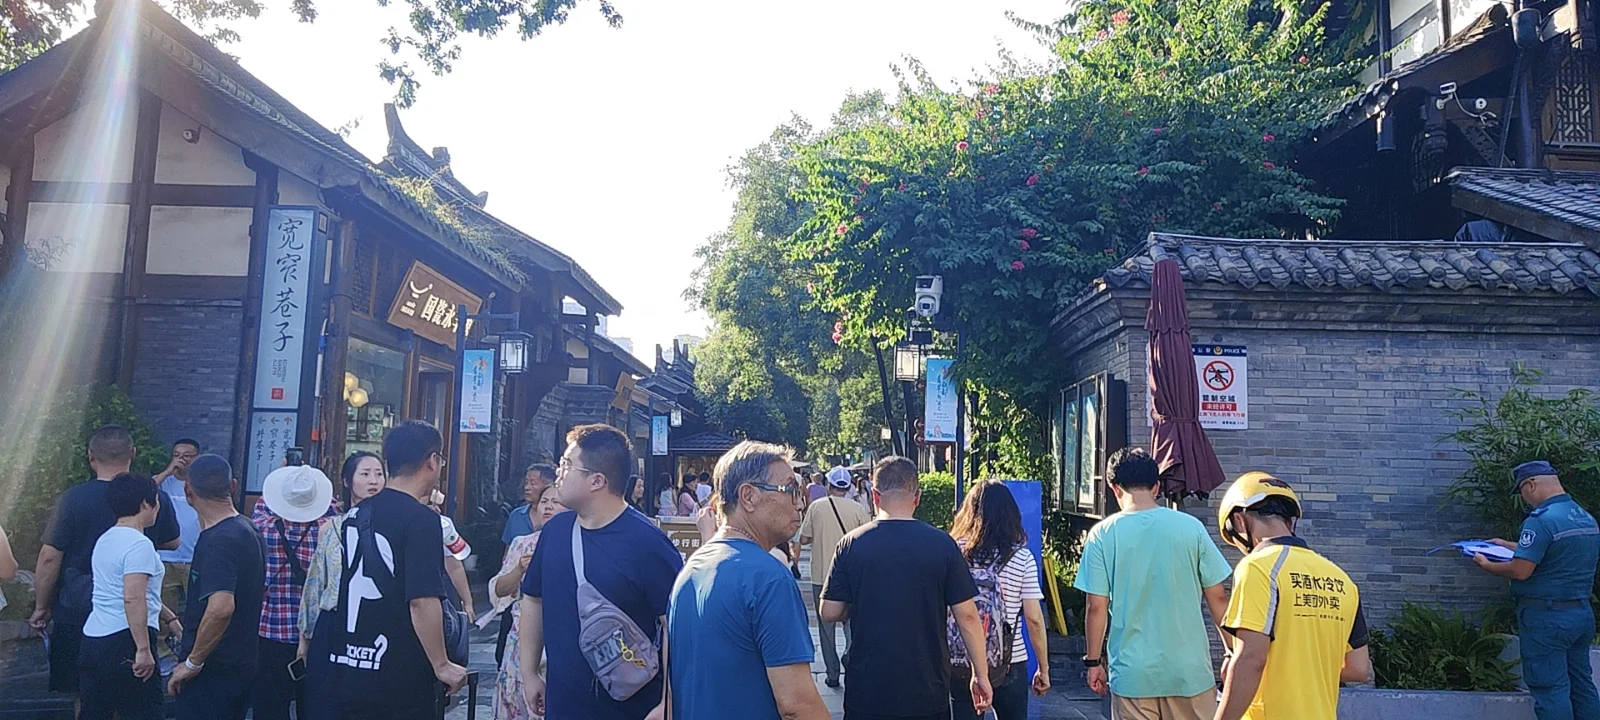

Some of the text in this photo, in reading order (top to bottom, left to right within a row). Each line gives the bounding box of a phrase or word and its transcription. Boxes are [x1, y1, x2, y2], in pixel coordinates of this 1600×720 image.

[270, 218, 304, 352] 宽窄巷子
[1206, 403, 1233, 411] 未经许可
[255, 427, 266, 461] 井巷子
[268, 428, 279, 462] 窄巷子
[1289, 573, 1346, 595] 买酒水冷饮
